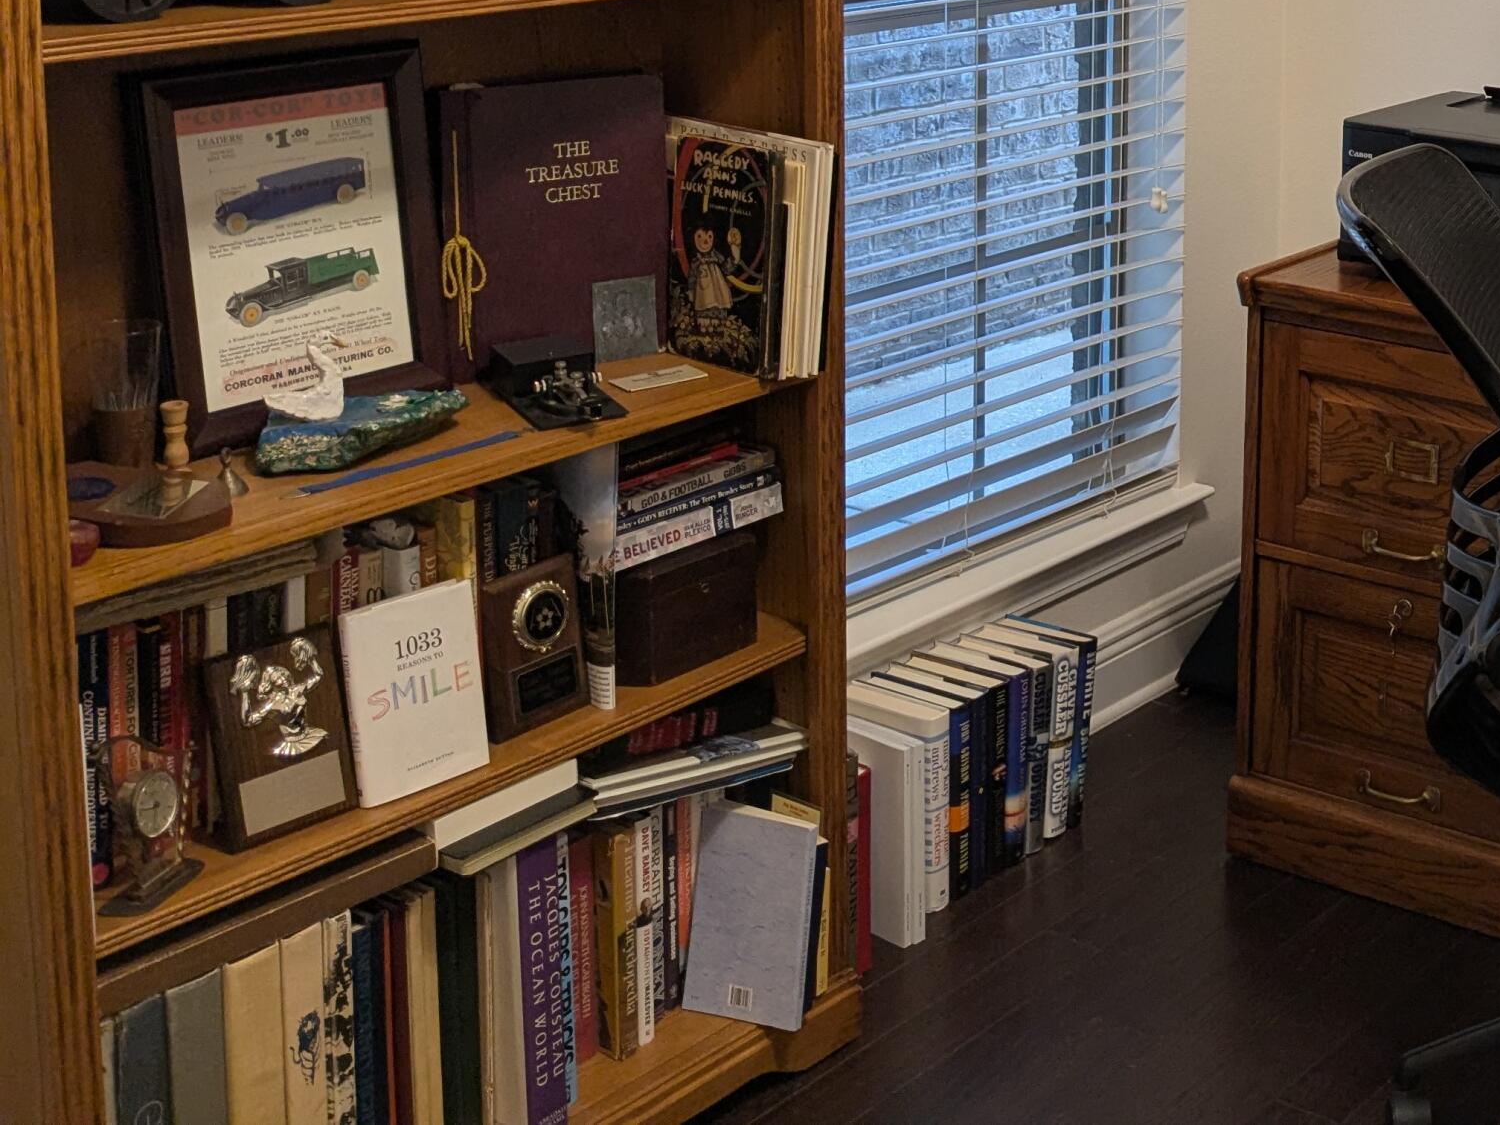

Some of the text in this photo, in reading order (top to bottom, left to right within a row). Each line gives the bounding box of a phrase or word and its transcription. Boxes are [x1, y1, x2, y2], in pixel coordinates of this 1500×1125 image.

[324, 87, 384, 107] TOYS
[525, 159, 621, 184] TREASURE
[553, 140, 592, 159] THE
[693, 148, 751, 170] RAGGEDY
[1348, 149, 1373, 160] Canon
[545, 183, 603, 204] CHEST
[680, 180, 711, 196] LUCKY
[702, 167, 738, 185] ANN'S
[224, 369, 284, 393] CORCORAN
[377, 345, 395, 358] CO.
[640, 494, 661, 509] GOD
[660, 491, 668, 502] &
[668, 473, 714, 500] FOOTBALL
[722, 461, 747, 479] GIBBS
[689, 498, 701, 509] The
[701, 493, 717, 508] Terry
[739, 481, 755, 494] Story
[623, 529, 682, 560] BELIEVED
[395, 627, 444, 661] 1,033
[396, 650, 445, 672] REASONS TO
[125, 650, 137, 715] TORTURED
[367, 659, 474, 722] SMILE
[1020, 678, 1029, 709] JOHN
[1033, 672, 1046, 733] CUSSLER
[1055, 659, 1070, 736] CUSSLER
[1067, 668, 1078, 721] CLIVE
[1082, 664, 1095, 720] WHITE
[959, 720, 970, 743] JOHN
[995, 689, 1007, 760] THE TESTAMENT
[1019, 710, 1028, 764] GRISHAM
[931, 746, 943, 802] andrews
[959, 747, 970, 784] GRISHAM
[1051, 761, 1066, 815] FOUND
[1061, 748, 1073, 822] ATLANTIS
[1029, 763, 1042, 823] ODYSSEY
[641, 827, 651, 894] DAVE RAMSEY
[650, 809, 662, 908] GALBRAITH
[933, 812, 944, 867] wreckers
[668, 855, 677, 880] Buying
[669, 896, 677, 921] Selling
[527, 880, 550, 1088] THE OCEAN WORLD
[543, 873, 565, 1078] JACQUES COUSTEAU
[623, 918, 639, 1016] Encyclopedia
